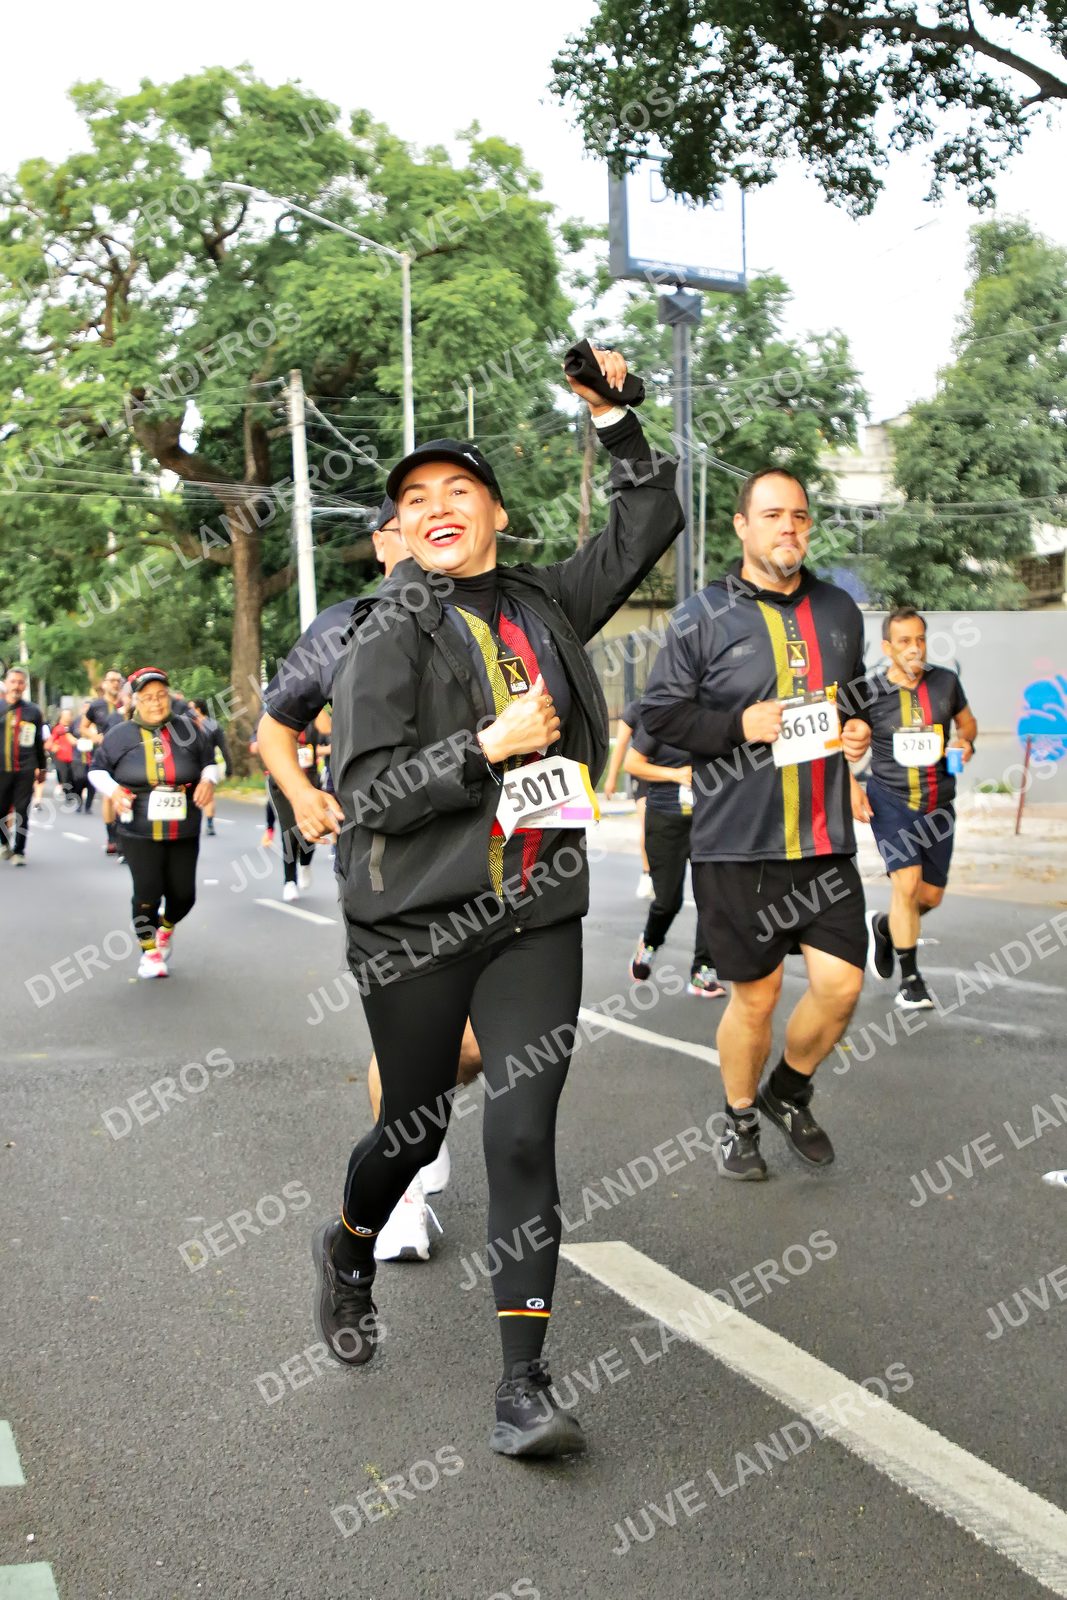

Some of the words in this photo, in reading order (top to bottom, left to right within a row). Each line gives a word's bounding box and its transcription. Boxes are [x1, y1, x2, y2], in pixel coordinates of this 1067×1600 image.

[781, 711, 830, 740] 6618
[902, 738, 932, 752] 5781
[503, 768, 570, 812] 5017
